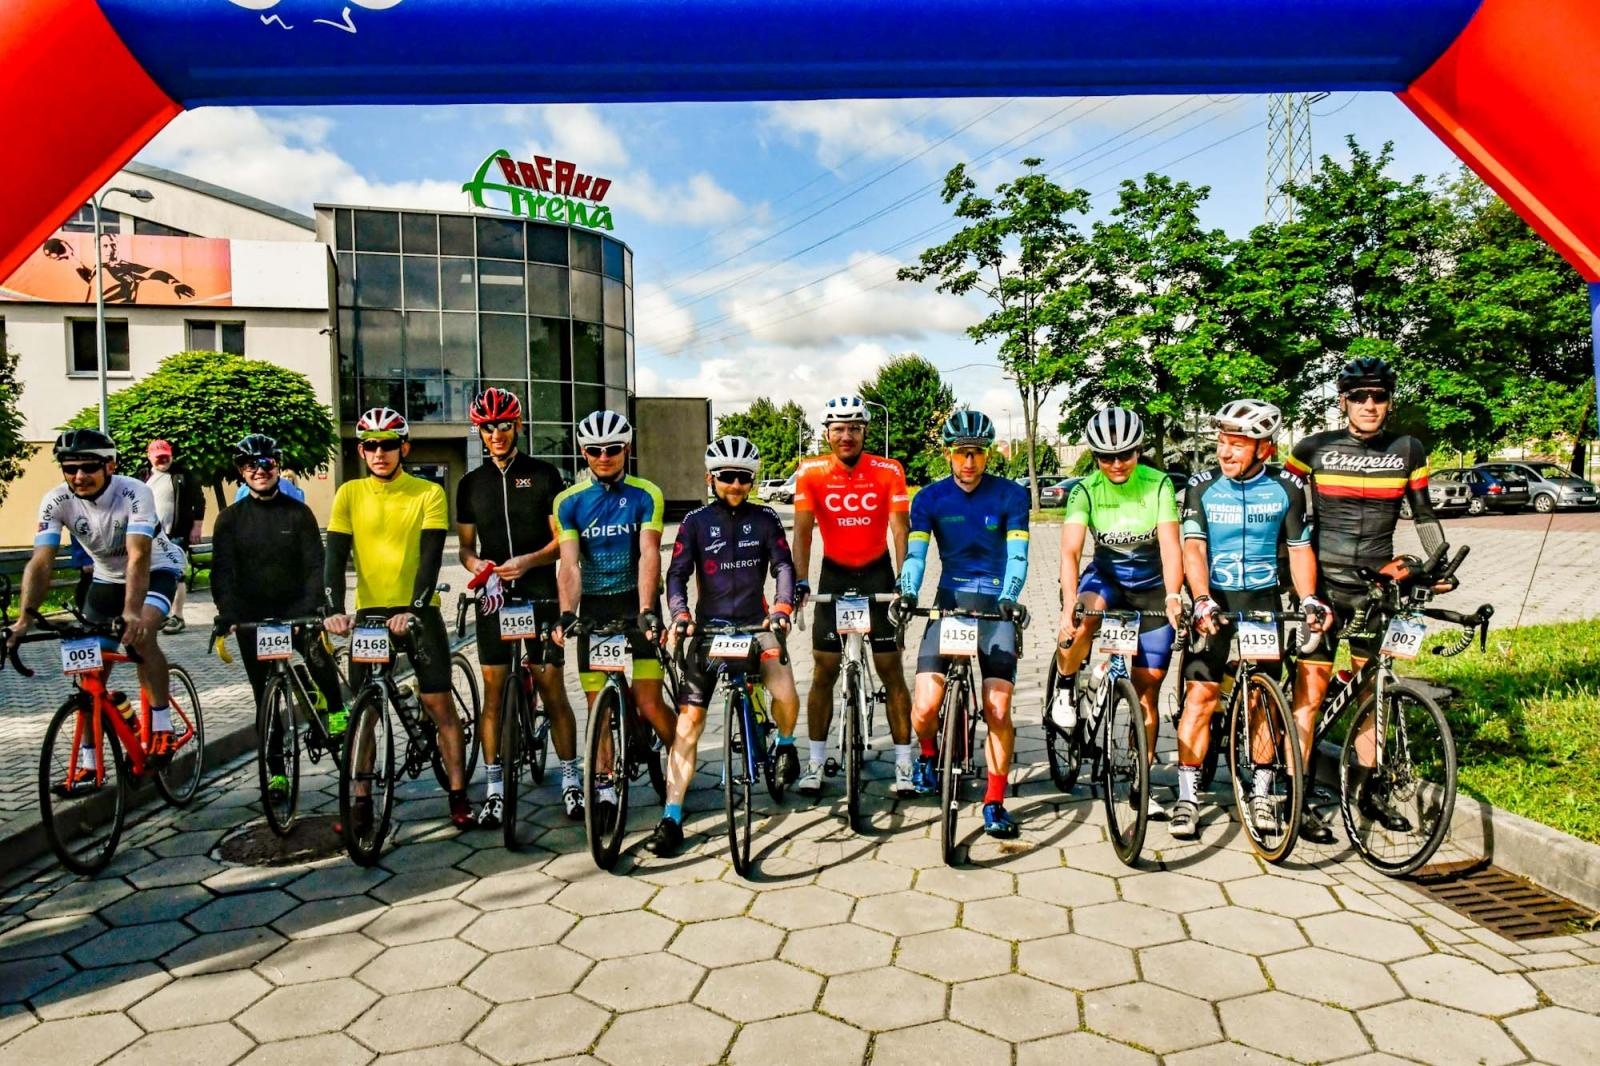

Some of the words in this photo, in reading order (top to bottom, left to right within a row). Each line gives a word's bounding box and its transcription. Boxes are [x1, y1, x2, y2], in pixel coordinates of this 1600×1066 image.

[1321, 451, 1405, 473] Grupetto
[825, 492, 878, 512] CCC
[837, 517, 871, 527] RENO
[1247, 514, 1264, 524] 610
[581, 518, 637, 539] ADIENT
[720, 559, 758, 570] INNERGY
[842, 610, 864, 621] 417
[502, 616, 533, 628] 4166
[943, 630, 976, 641] 4156
[1103, 629, 1136, 641] 4162
[1242, 634, 1276, 645] 4159
[1391, 632, 1417, 646] 002
[259, 636, 289, 647] 4164
[354, 639, 388, 650] 4168
[715, 641, 749, 649] 4160
[70, 648, 95, 661] 005
[594, 645, 621, 657] 136
